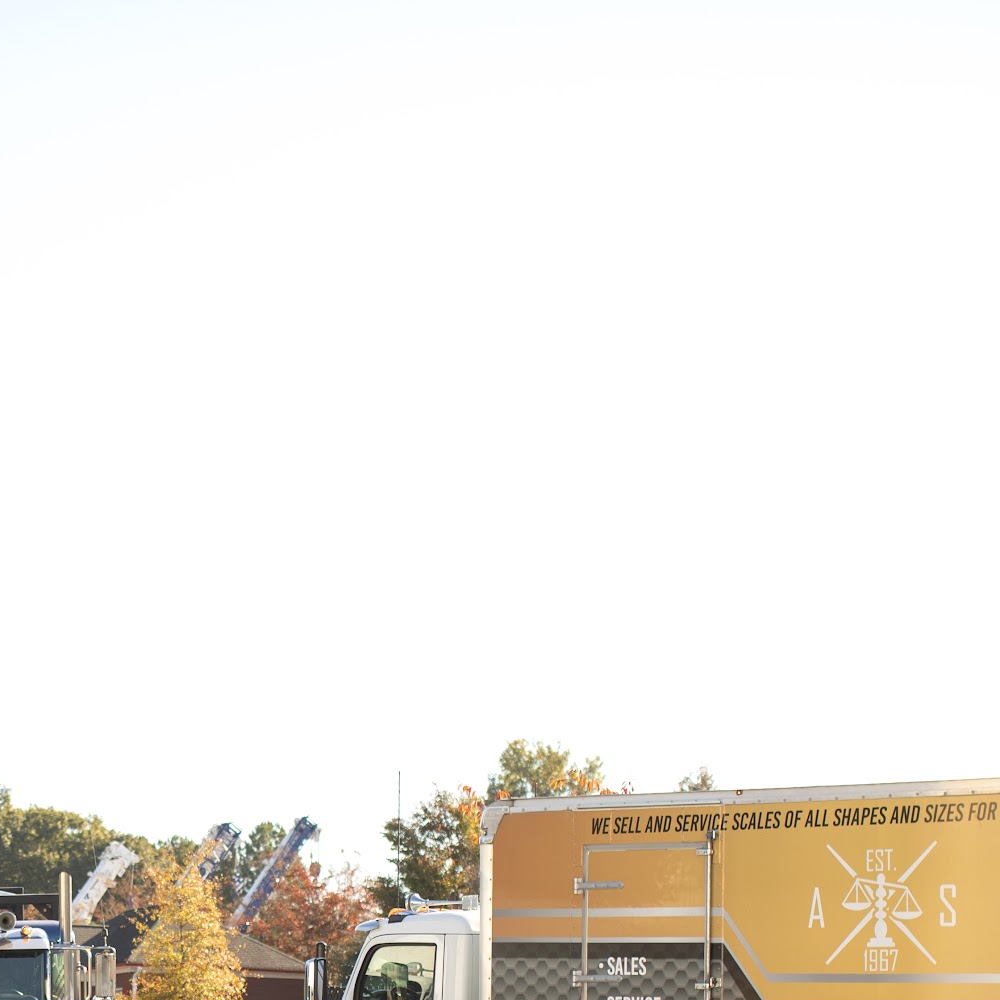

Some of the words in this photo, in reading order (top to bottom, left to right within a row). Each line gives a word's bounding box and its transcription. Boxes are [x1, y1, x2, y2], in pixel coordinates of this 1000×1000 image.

[591, 817, 611, 835] WE
[613, 816, 642, 834] SELL
[644, 815, 672, 833] AND
[674, 813, 730, 832] SERVICE
[732, 811, 781, 830] SCALES
[784, 810, 803, 828] OF
[804, 809, 830, 828] ALL
[833, 806, 887, 826] SHAPES
[890, 805, 921, 824] AND
[924, 803, 965, 823] SIZES
[967, 801, 998, 821] FOR
[866, 849, 897, 872] EST.
[808, 887, 825, 929] A
[939, 884, 957, 927] S
[607, 956, 647, 976] SALES
[863, 949, 899, 972] 1967
